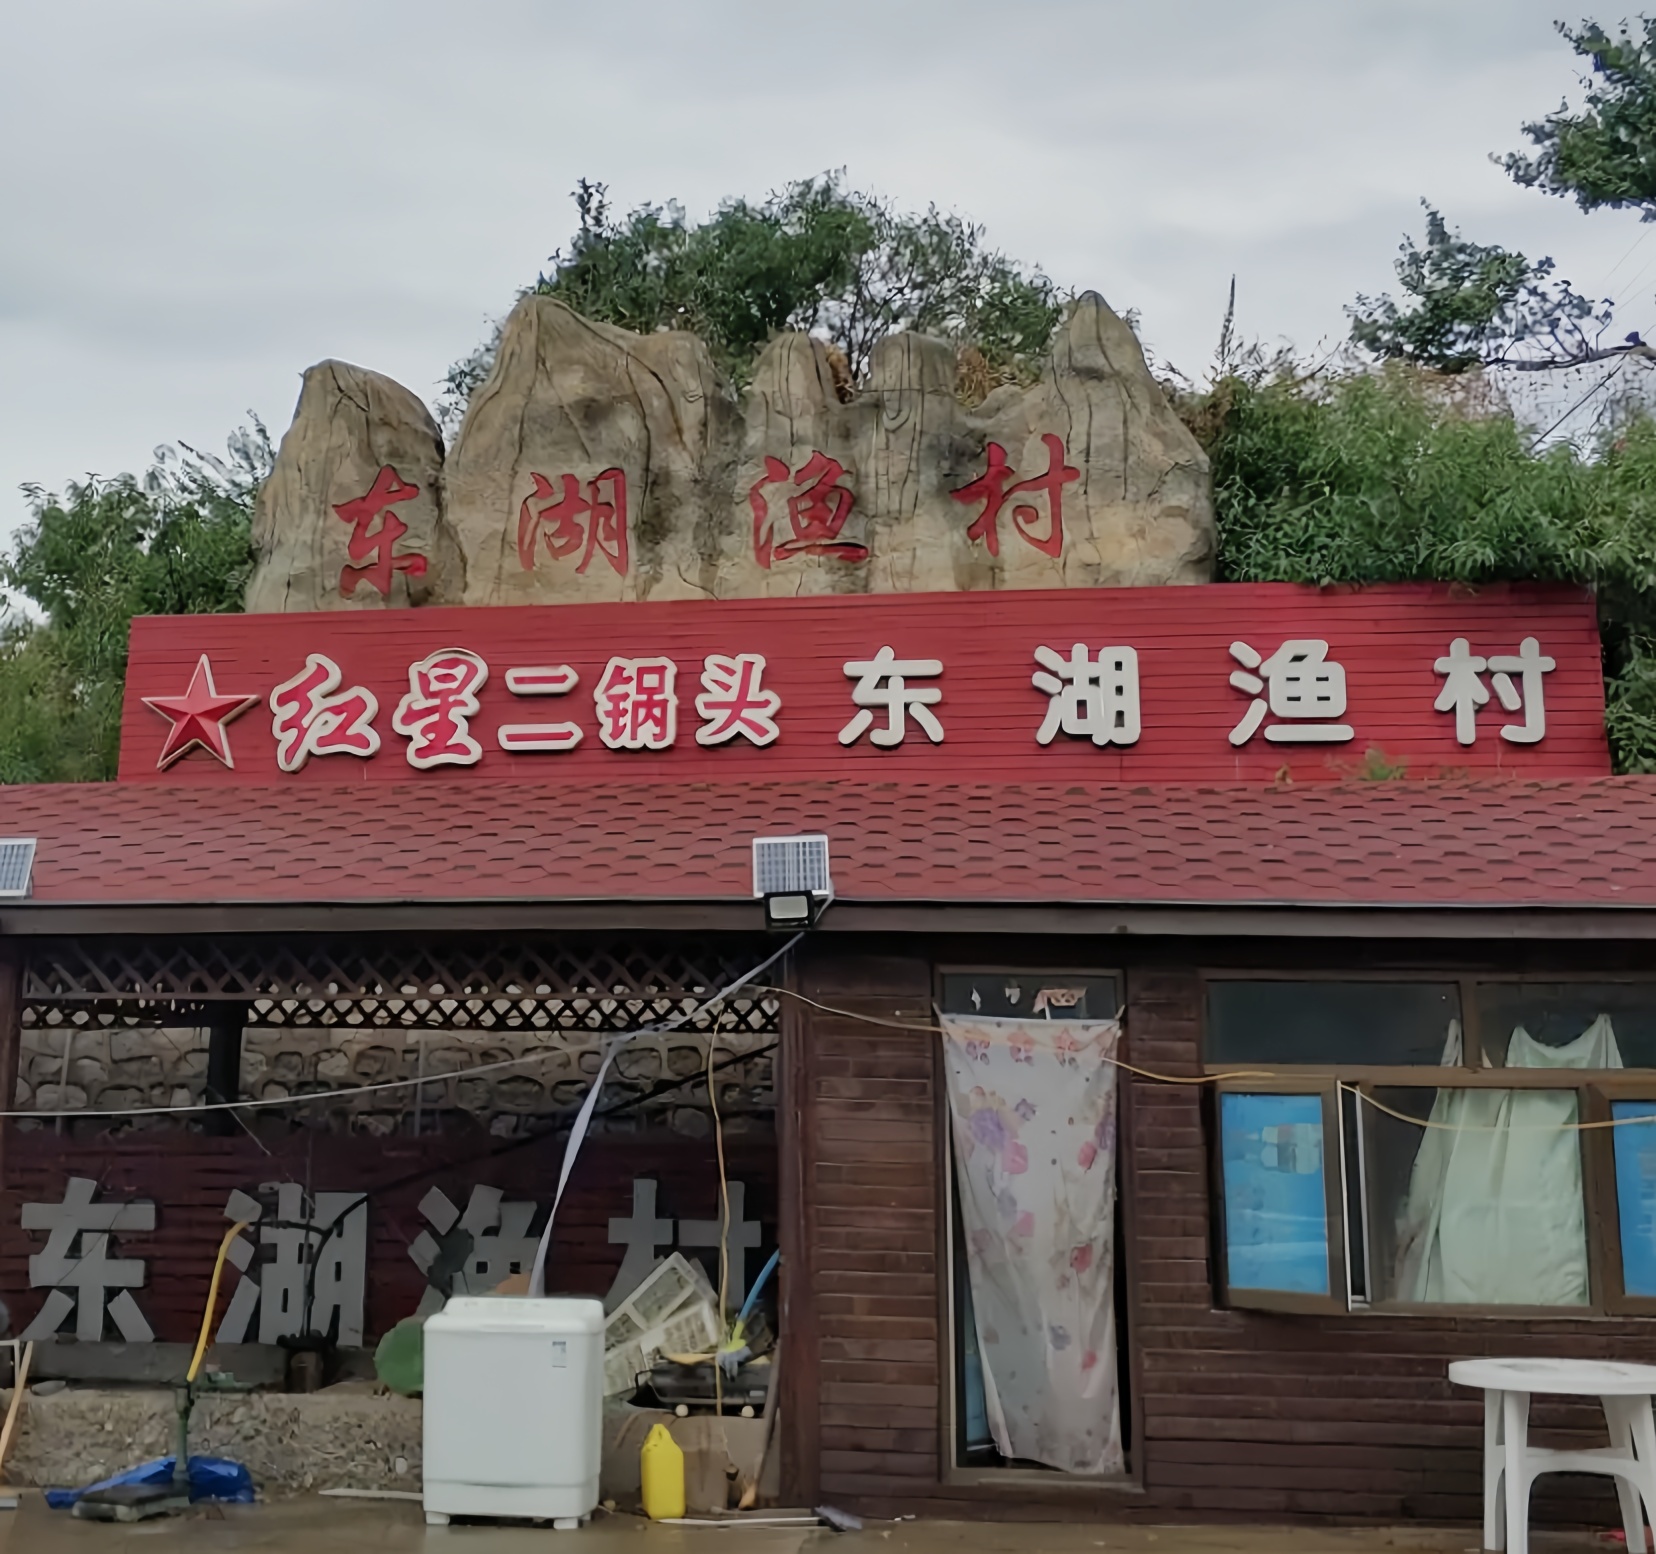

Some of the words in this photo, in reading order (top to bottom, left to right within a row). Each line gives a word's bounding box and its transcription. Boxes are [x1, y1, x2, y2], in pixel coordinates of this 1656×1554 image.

[333, 433, 1080, 597] 东湖渔村
[270, 648, 781, 772] 红星二锅头
[838, 636, 1557, 746] 东湖渔村
